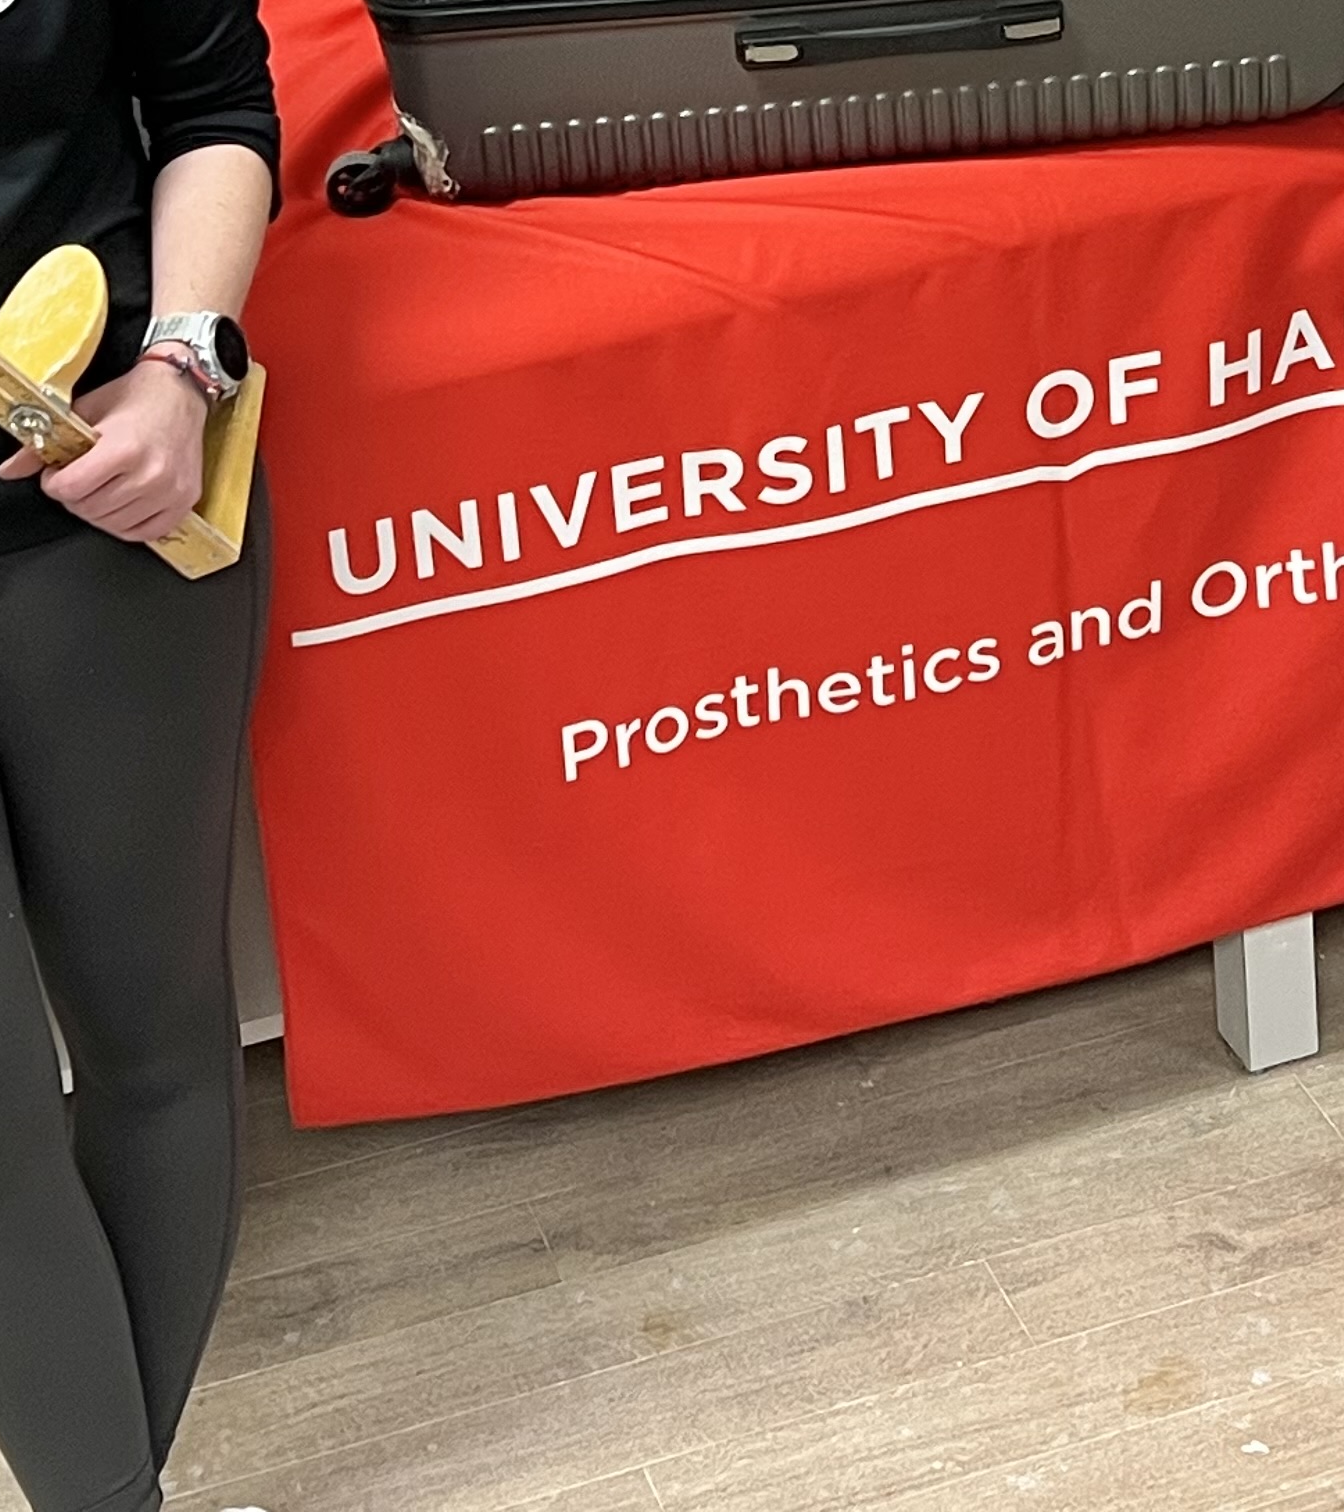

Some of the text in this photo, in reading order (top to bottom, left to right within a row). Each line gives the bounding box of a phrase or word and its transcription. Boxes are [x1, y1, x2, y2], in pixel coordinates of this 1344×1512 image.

[328, 392, 985, 595] UNIVERSITY
[1026, 350, 1162, 439] OF
[561, 638, 1000, 782] Prosthetics
[1028, 580, 1162, 666] and
